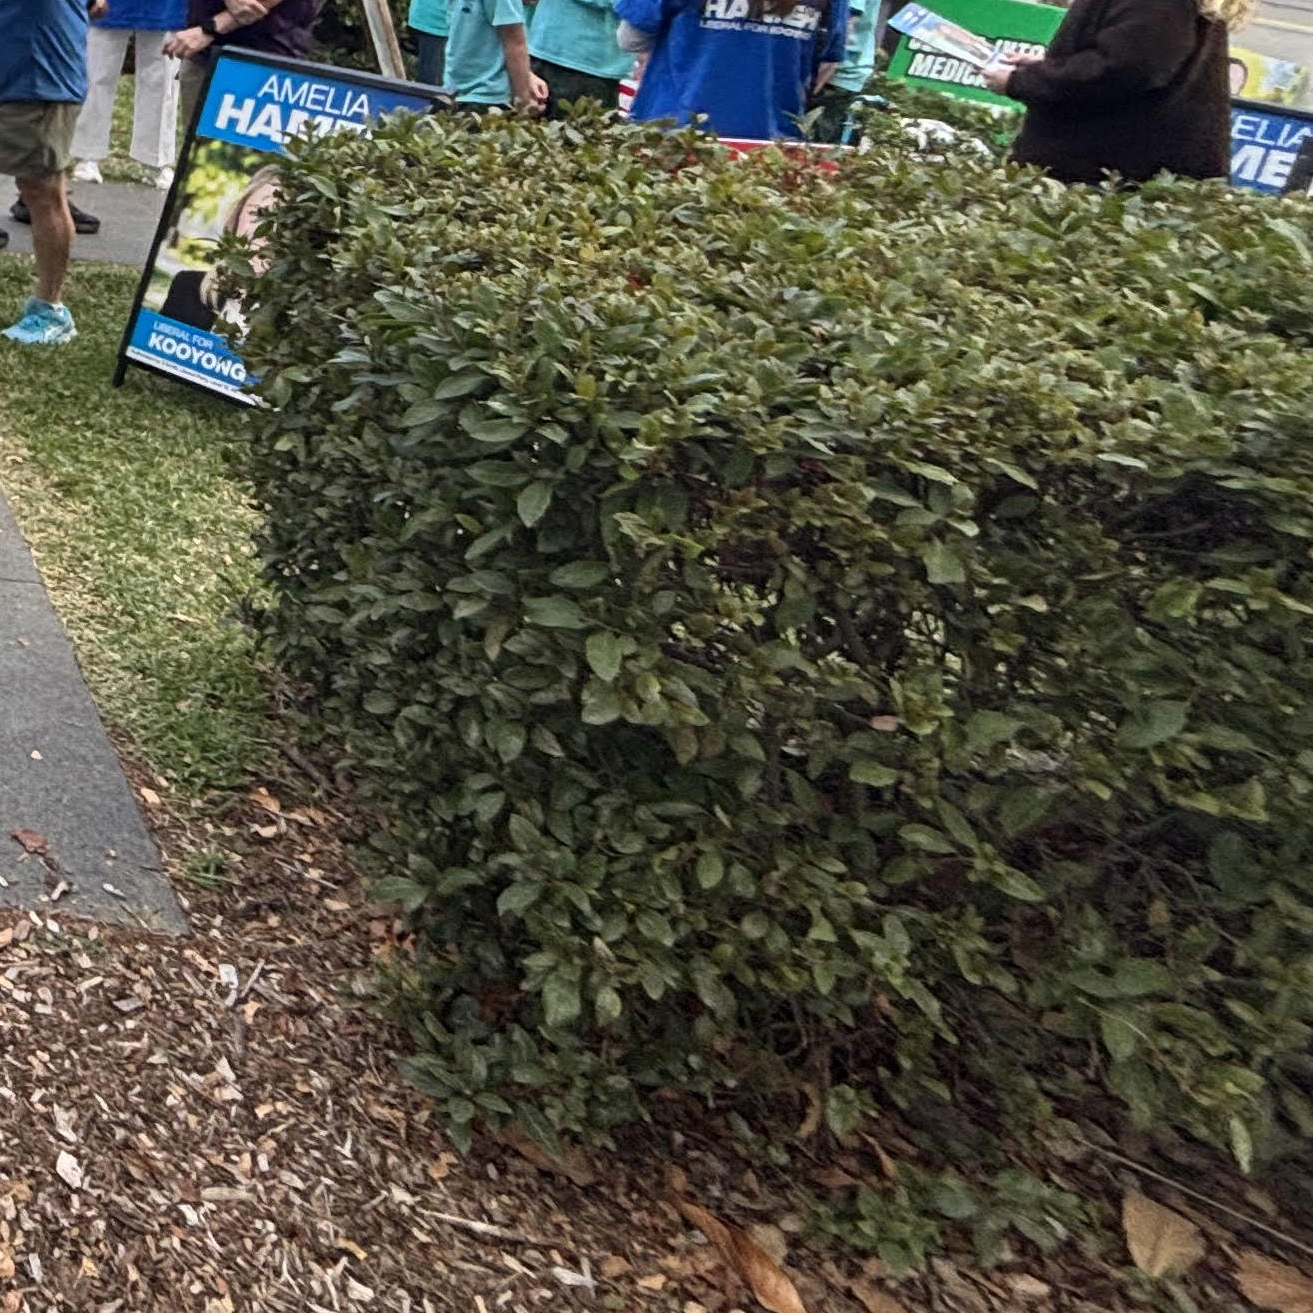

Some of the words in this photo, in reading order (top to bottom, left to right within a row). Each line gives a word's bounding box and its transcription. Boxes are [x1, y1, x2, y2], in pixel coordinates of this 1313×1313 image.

[257, 74, 371, 117] AMELIA
[215, 93, 374, 145] HAM
[1230, 113, 1313, 148] ELIA
[148, 332, 247, 382] KOOYONG
[192, 334, 214, 350] FOR
